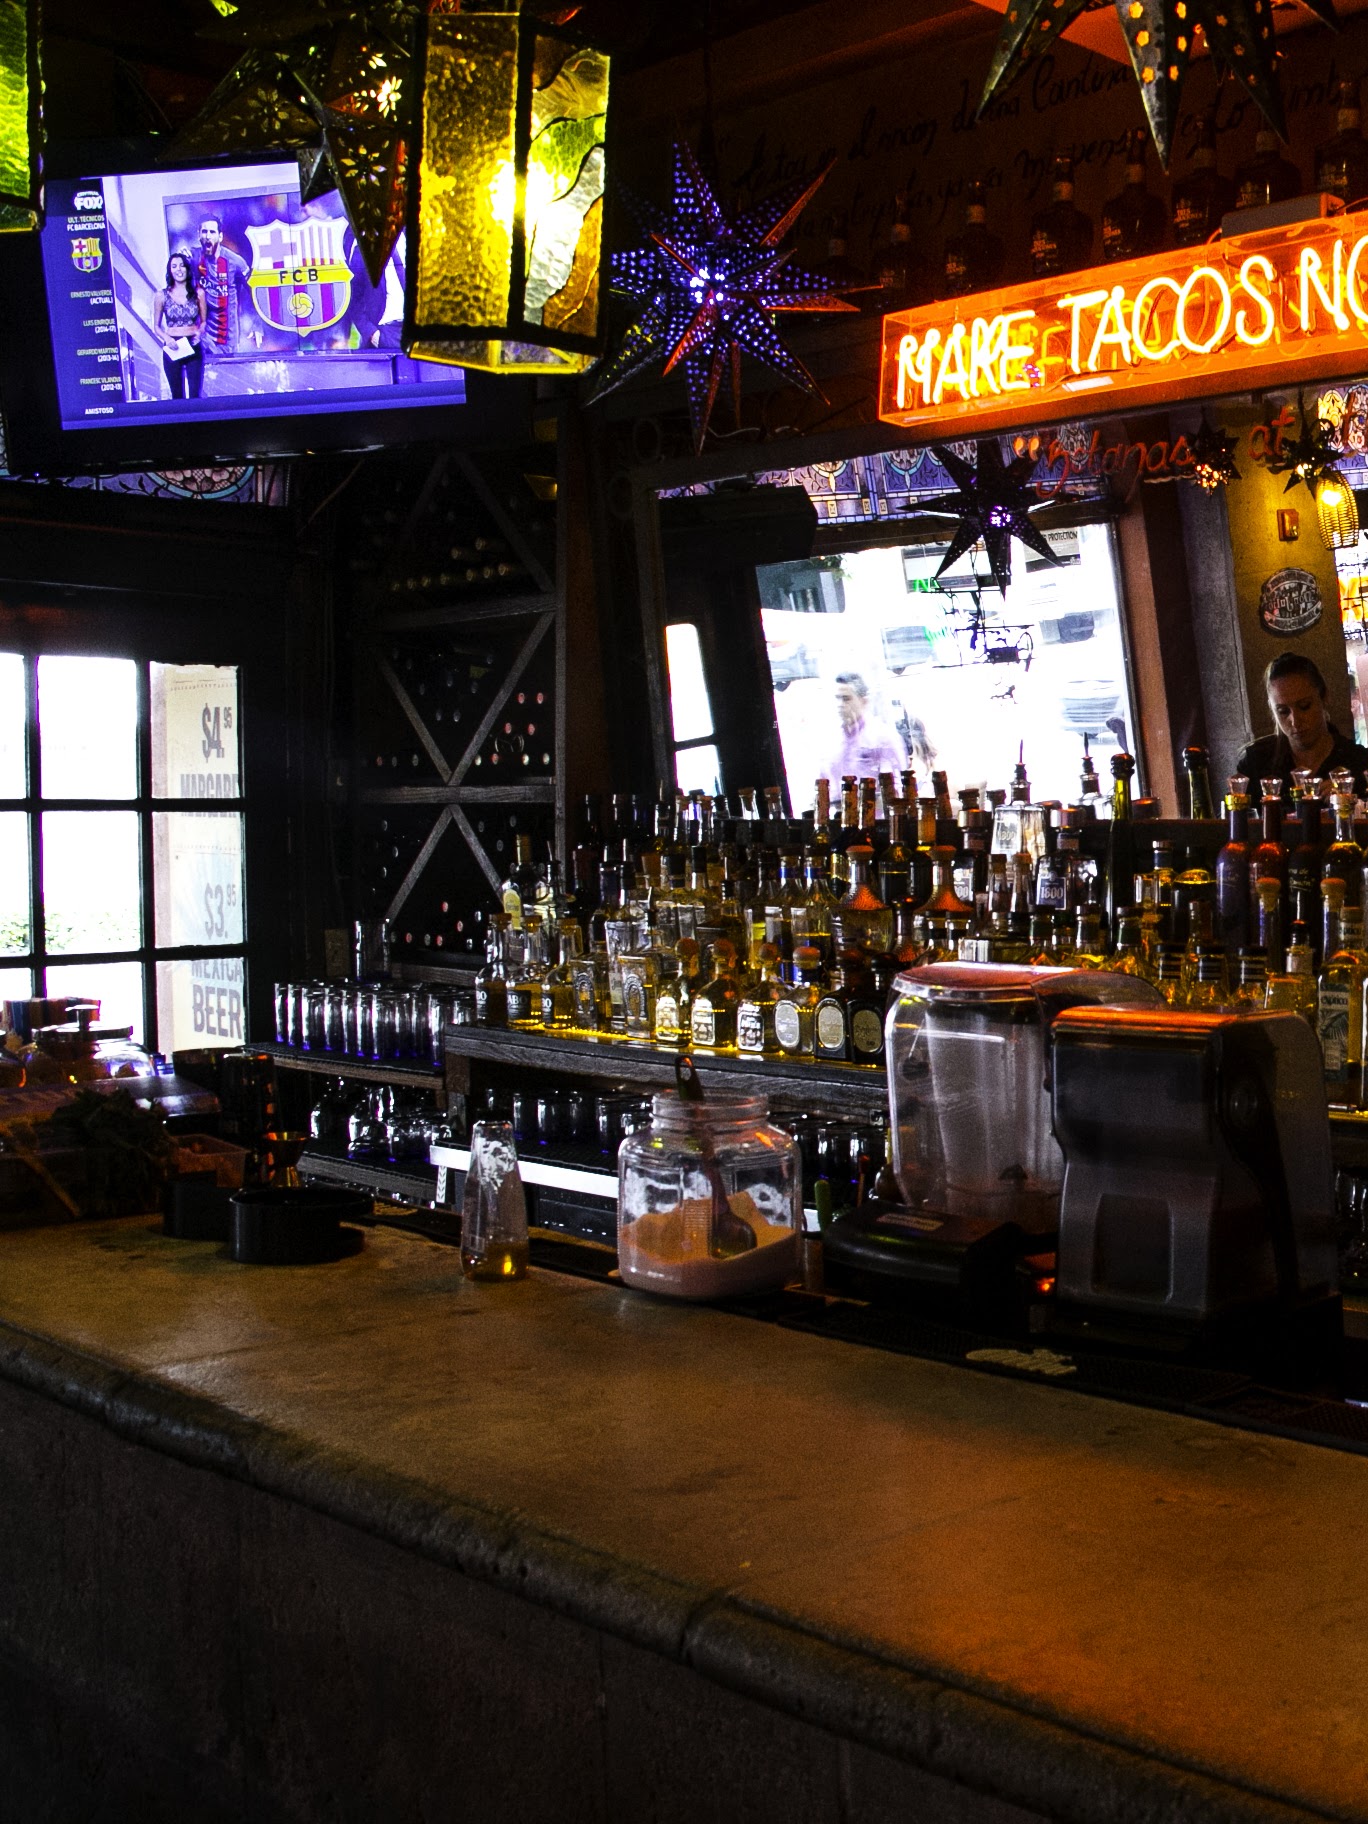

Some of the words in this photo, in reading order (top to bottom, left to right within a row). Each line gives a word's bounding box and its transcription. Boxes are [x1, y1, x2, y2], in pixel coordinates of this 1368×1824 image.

[280, 268, 318, 284] FCB
[895, 308, 1037, 409] MAKE
[1057, 254, 1276, 376] TACOS
[1040, 886, 1064, 900] 1800
[192, 983, 243, 1040] BEER
